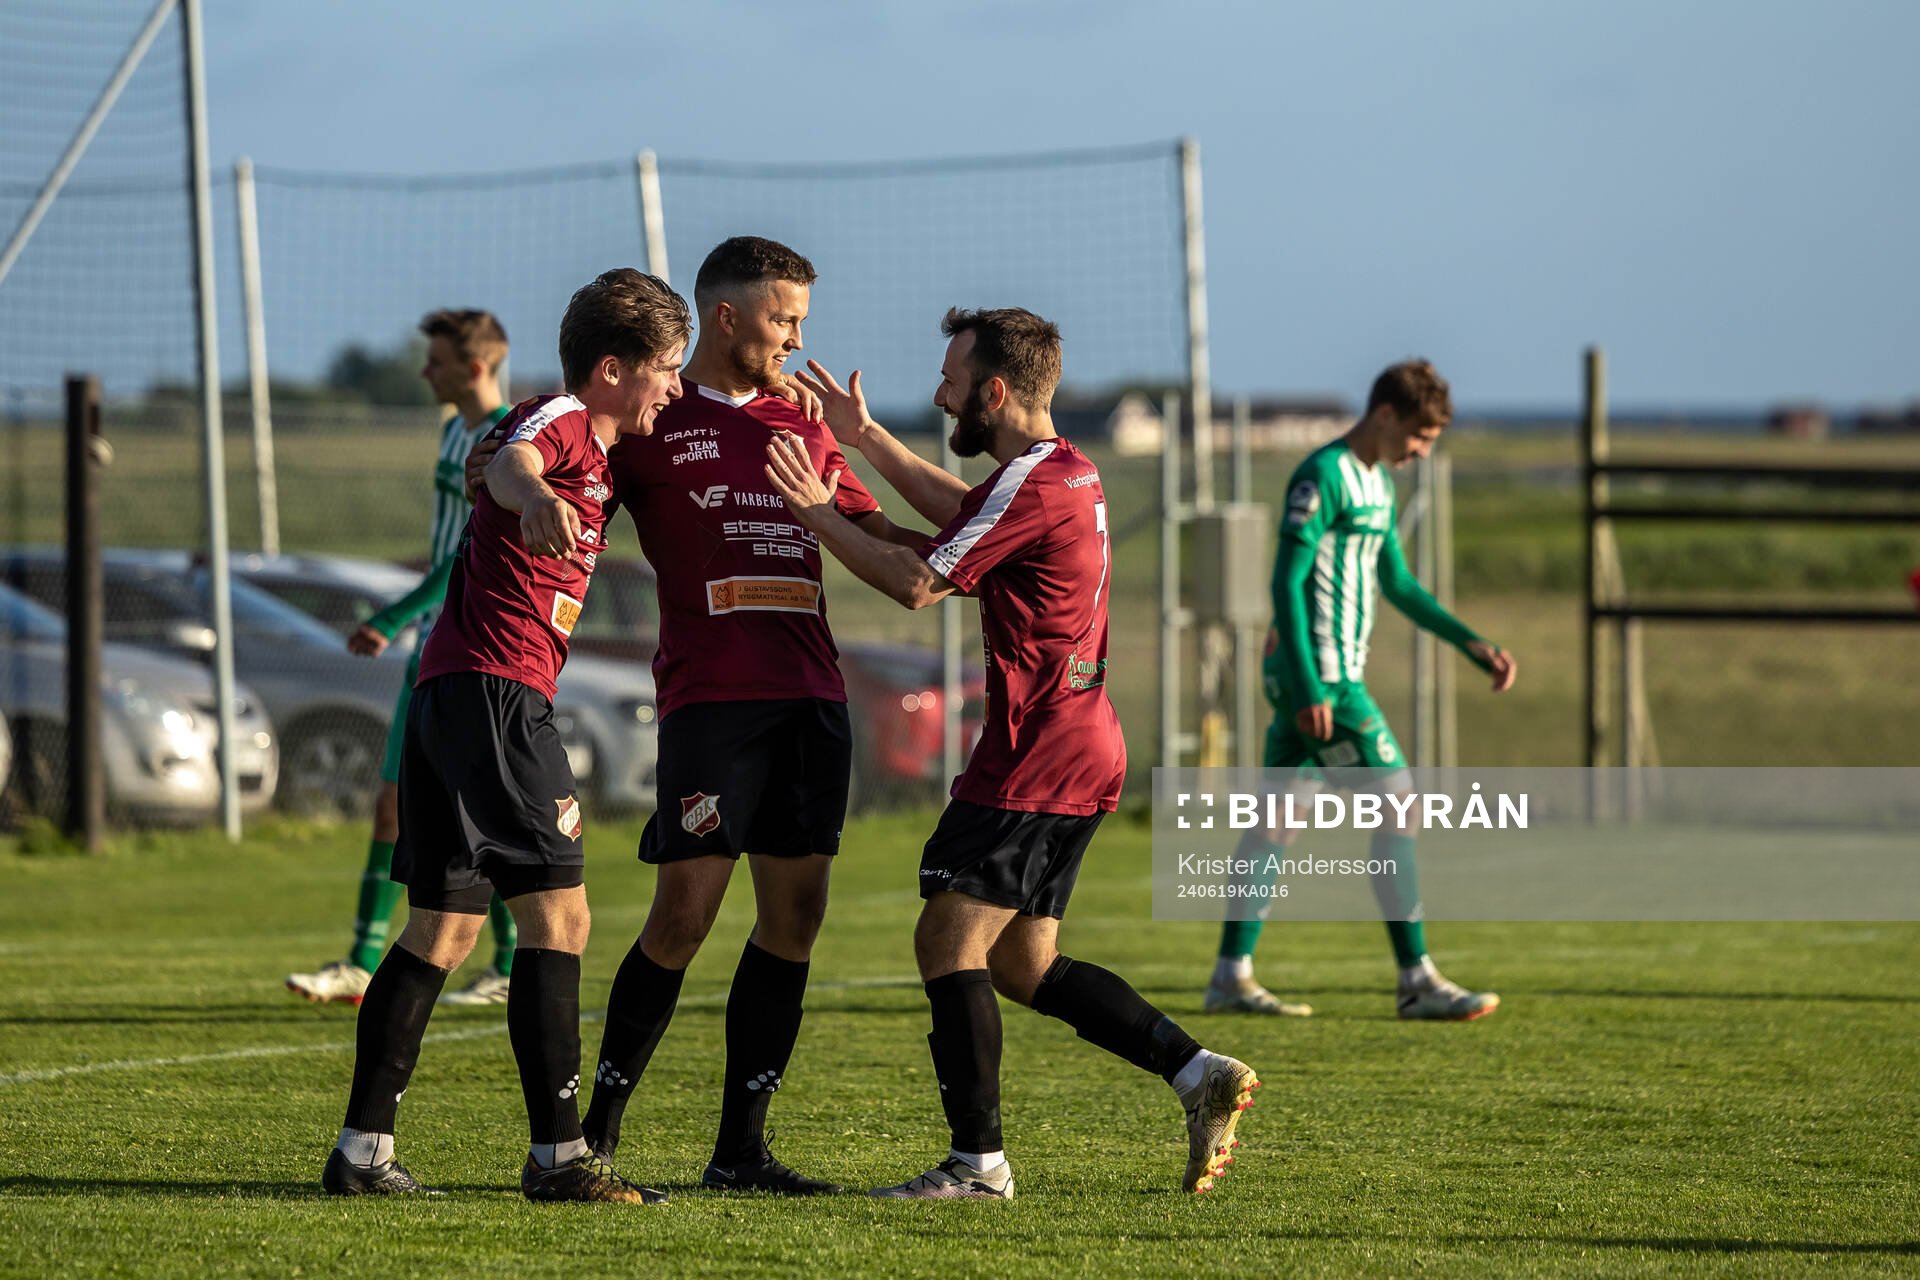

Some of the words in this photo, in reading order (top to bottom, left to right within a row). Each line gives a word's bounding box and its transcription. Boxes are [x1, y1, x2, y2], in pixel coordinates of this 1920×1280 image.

[664, 429, 707, 442] CRAFT
[687, 441, 718, 451] TEAM
[672, 449, 720, 465] SPORTIA
[733, 492, 784, 508] VARBERG
[1377, 731, 1397, 763] 6
